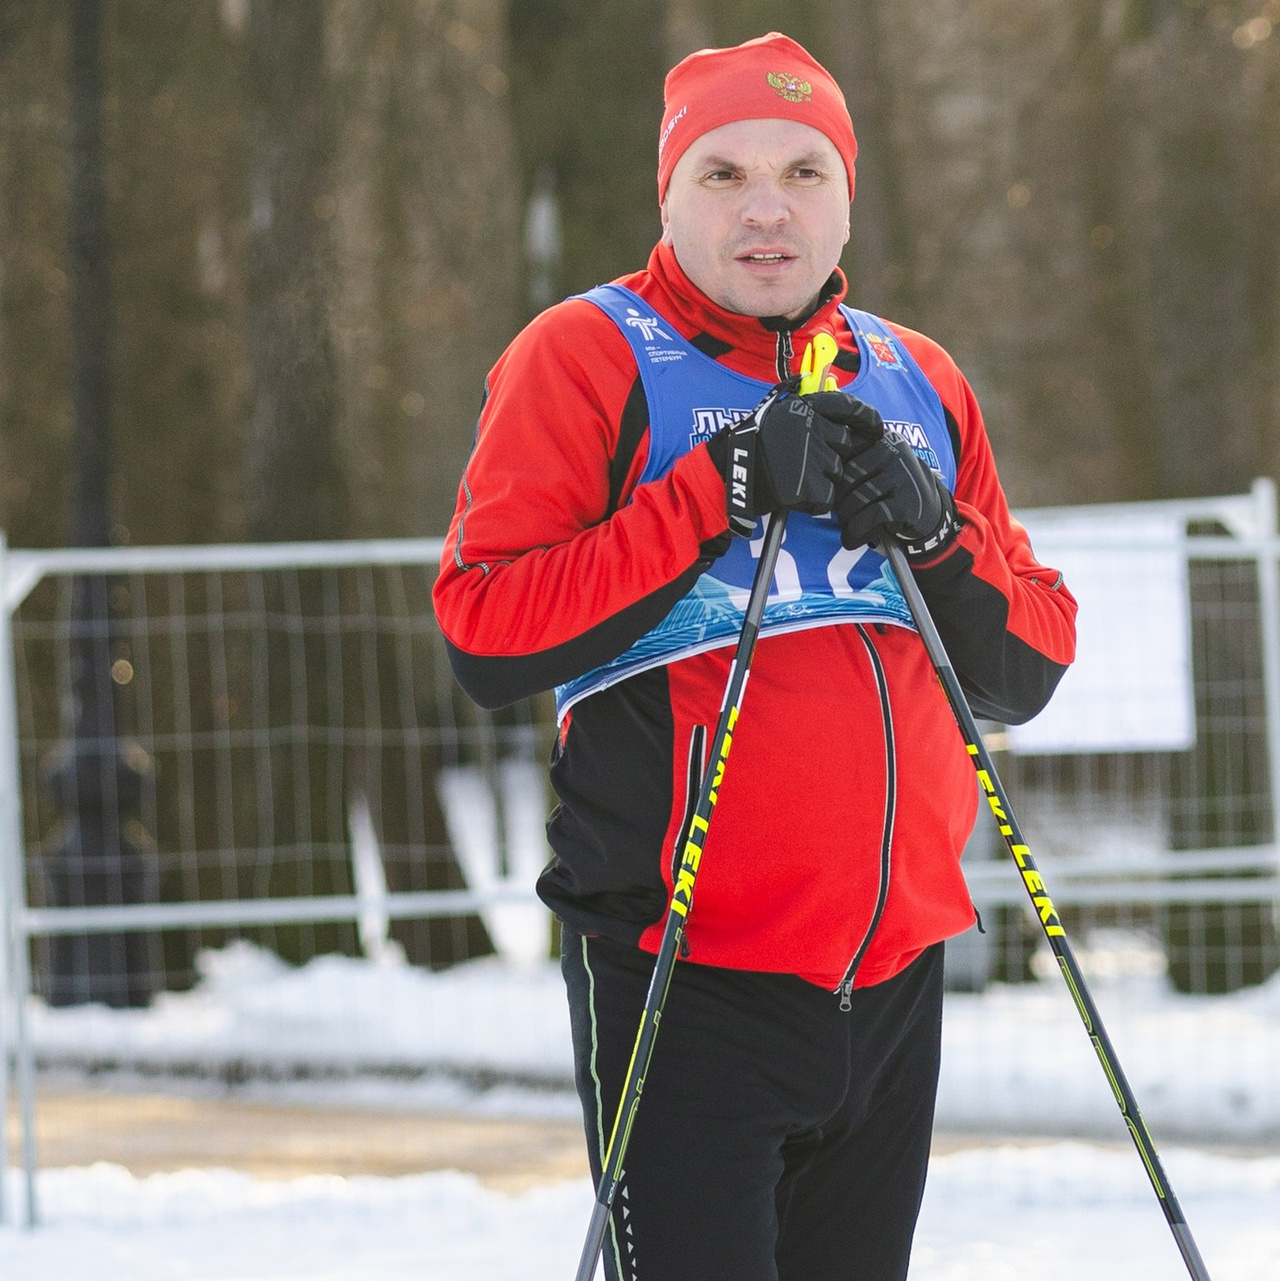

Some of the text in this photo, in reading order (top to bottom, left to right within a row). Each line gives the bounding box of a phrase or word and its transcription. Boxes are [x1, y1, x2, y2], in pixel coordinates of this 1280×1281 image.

[732, 447, 748, 508] LEKI
[907, 510, 951, 554] LEKI
[670, 814, 709, 917] LEKI
[1011, 844, 1066, 937] LEKI
